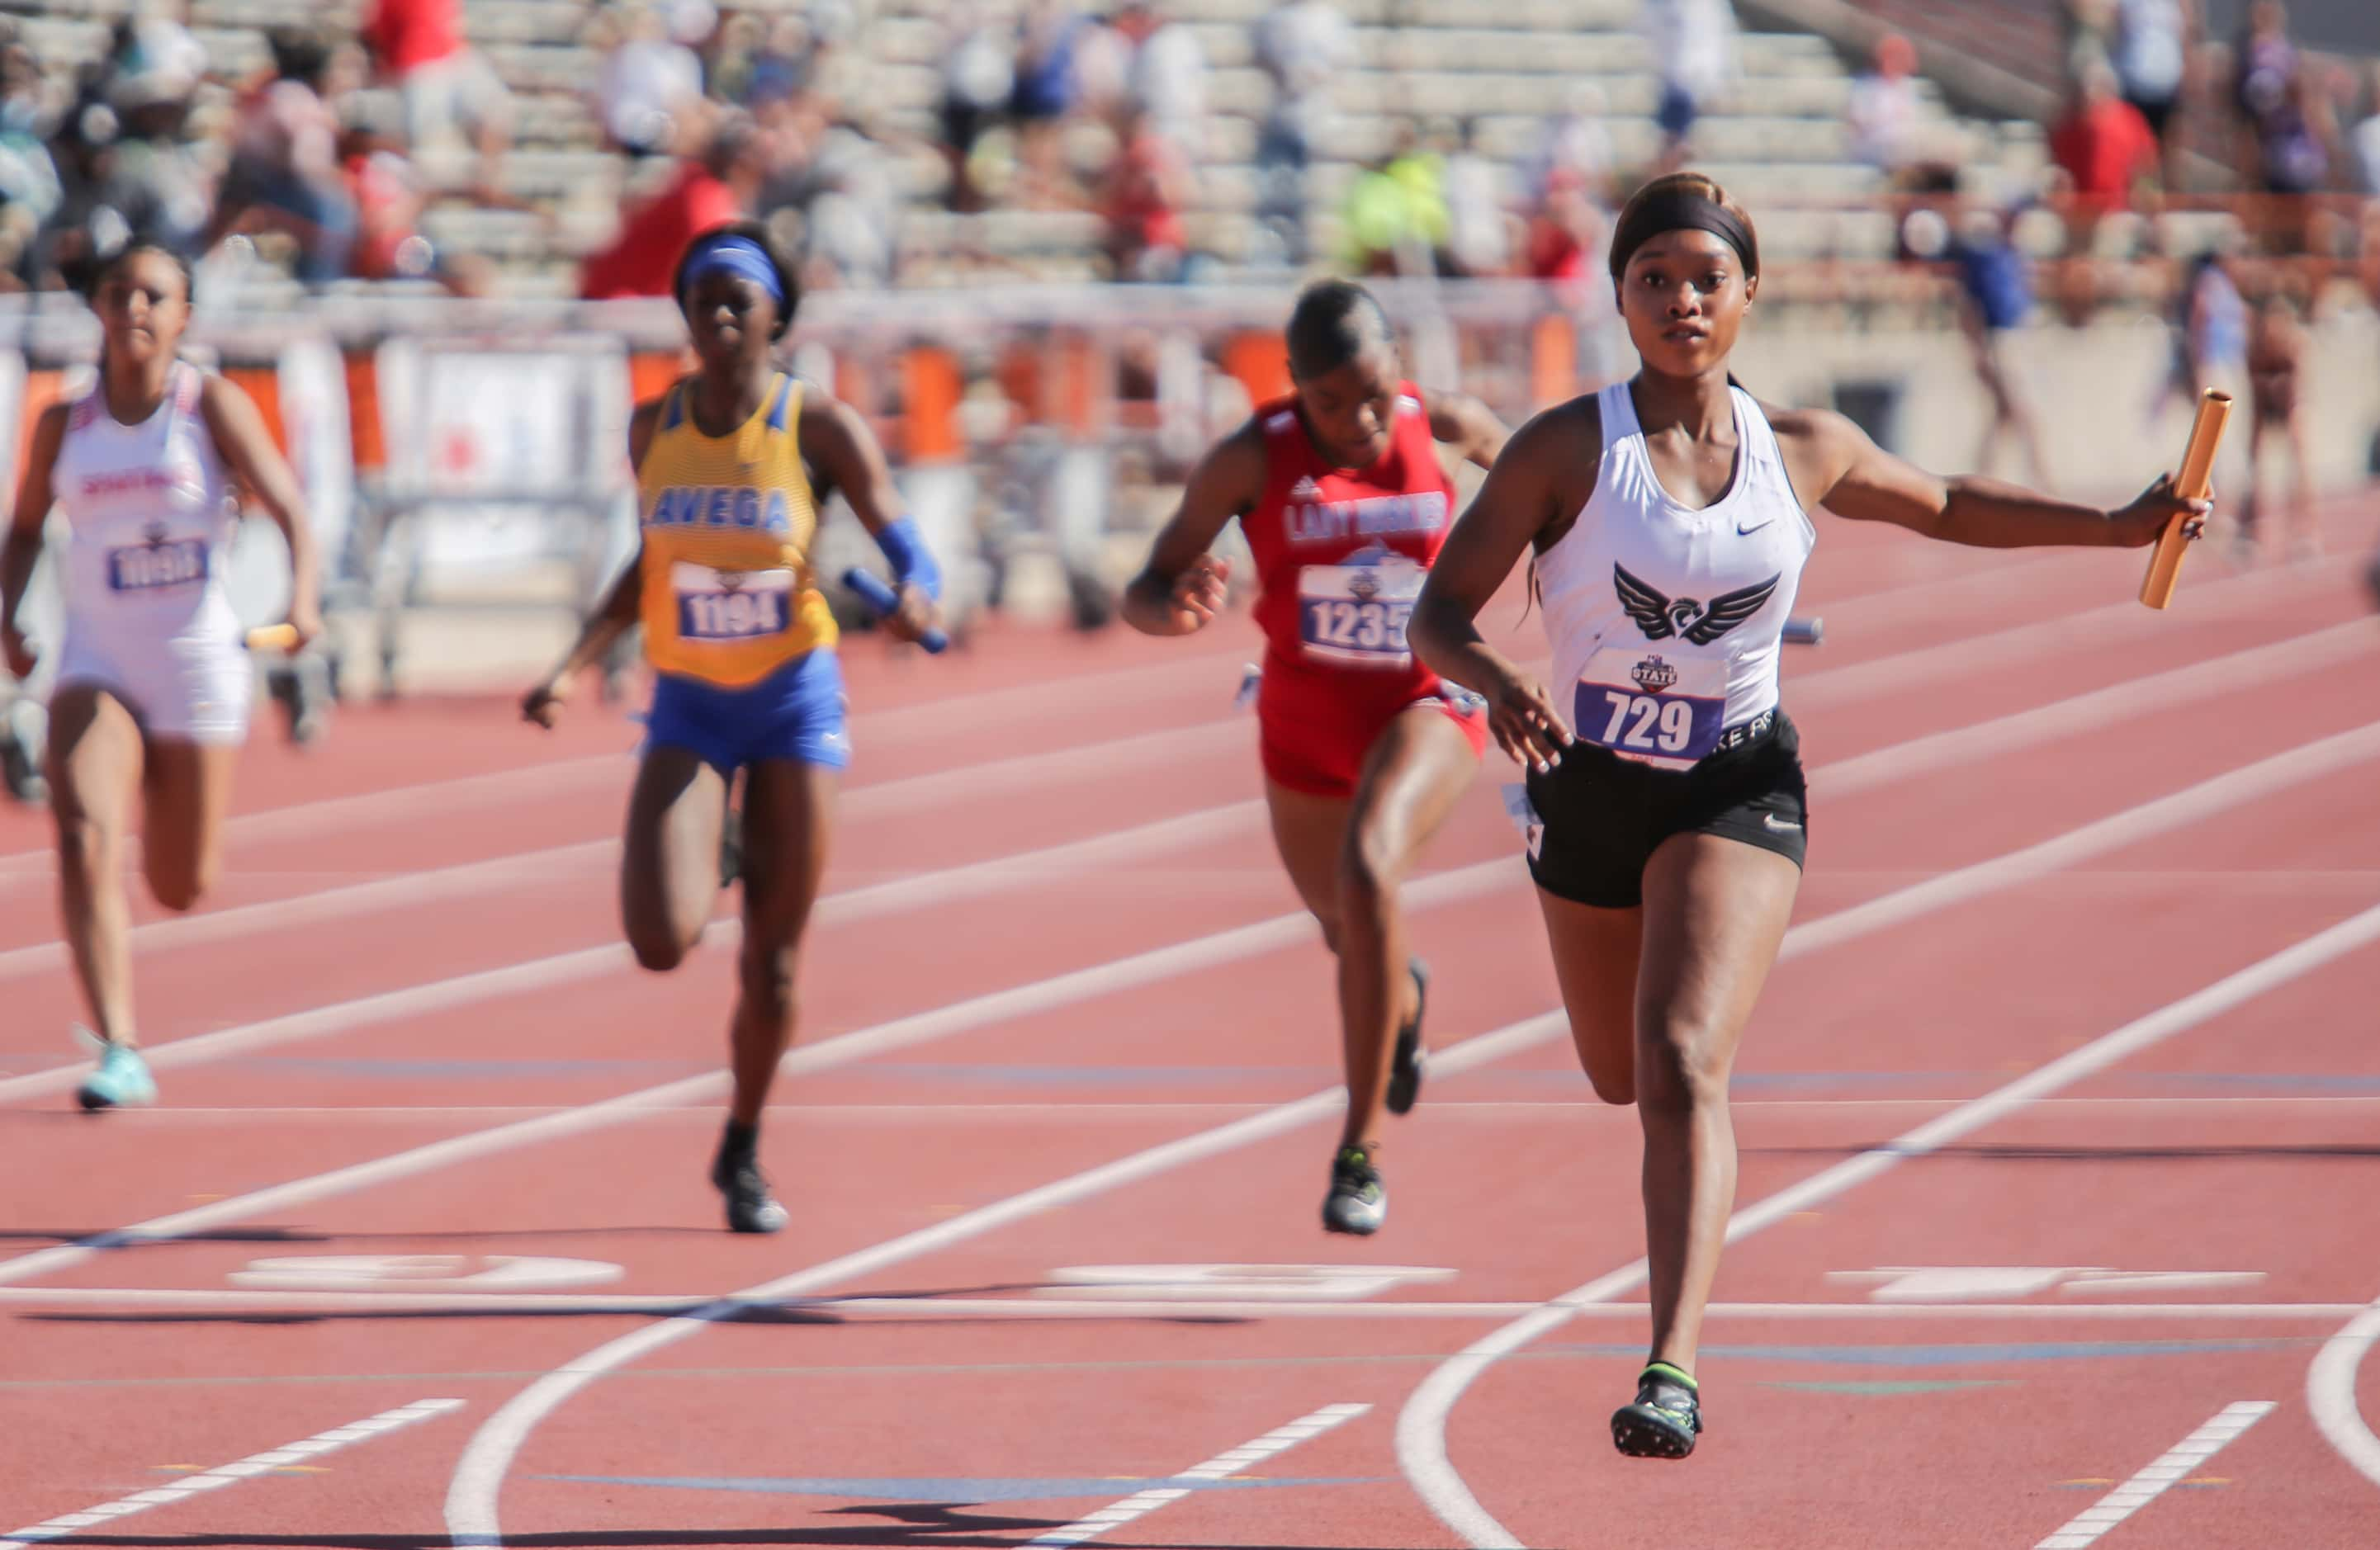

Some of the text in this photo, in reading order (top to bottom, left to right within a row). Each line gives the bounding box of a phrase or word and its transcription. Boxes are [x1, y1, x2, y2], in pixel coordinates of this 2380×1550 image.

[1312, 601, 1411, 647] 1235
[1633, 667, 1677, 684] STATE
[1603, 690, 1692, 752] 729
